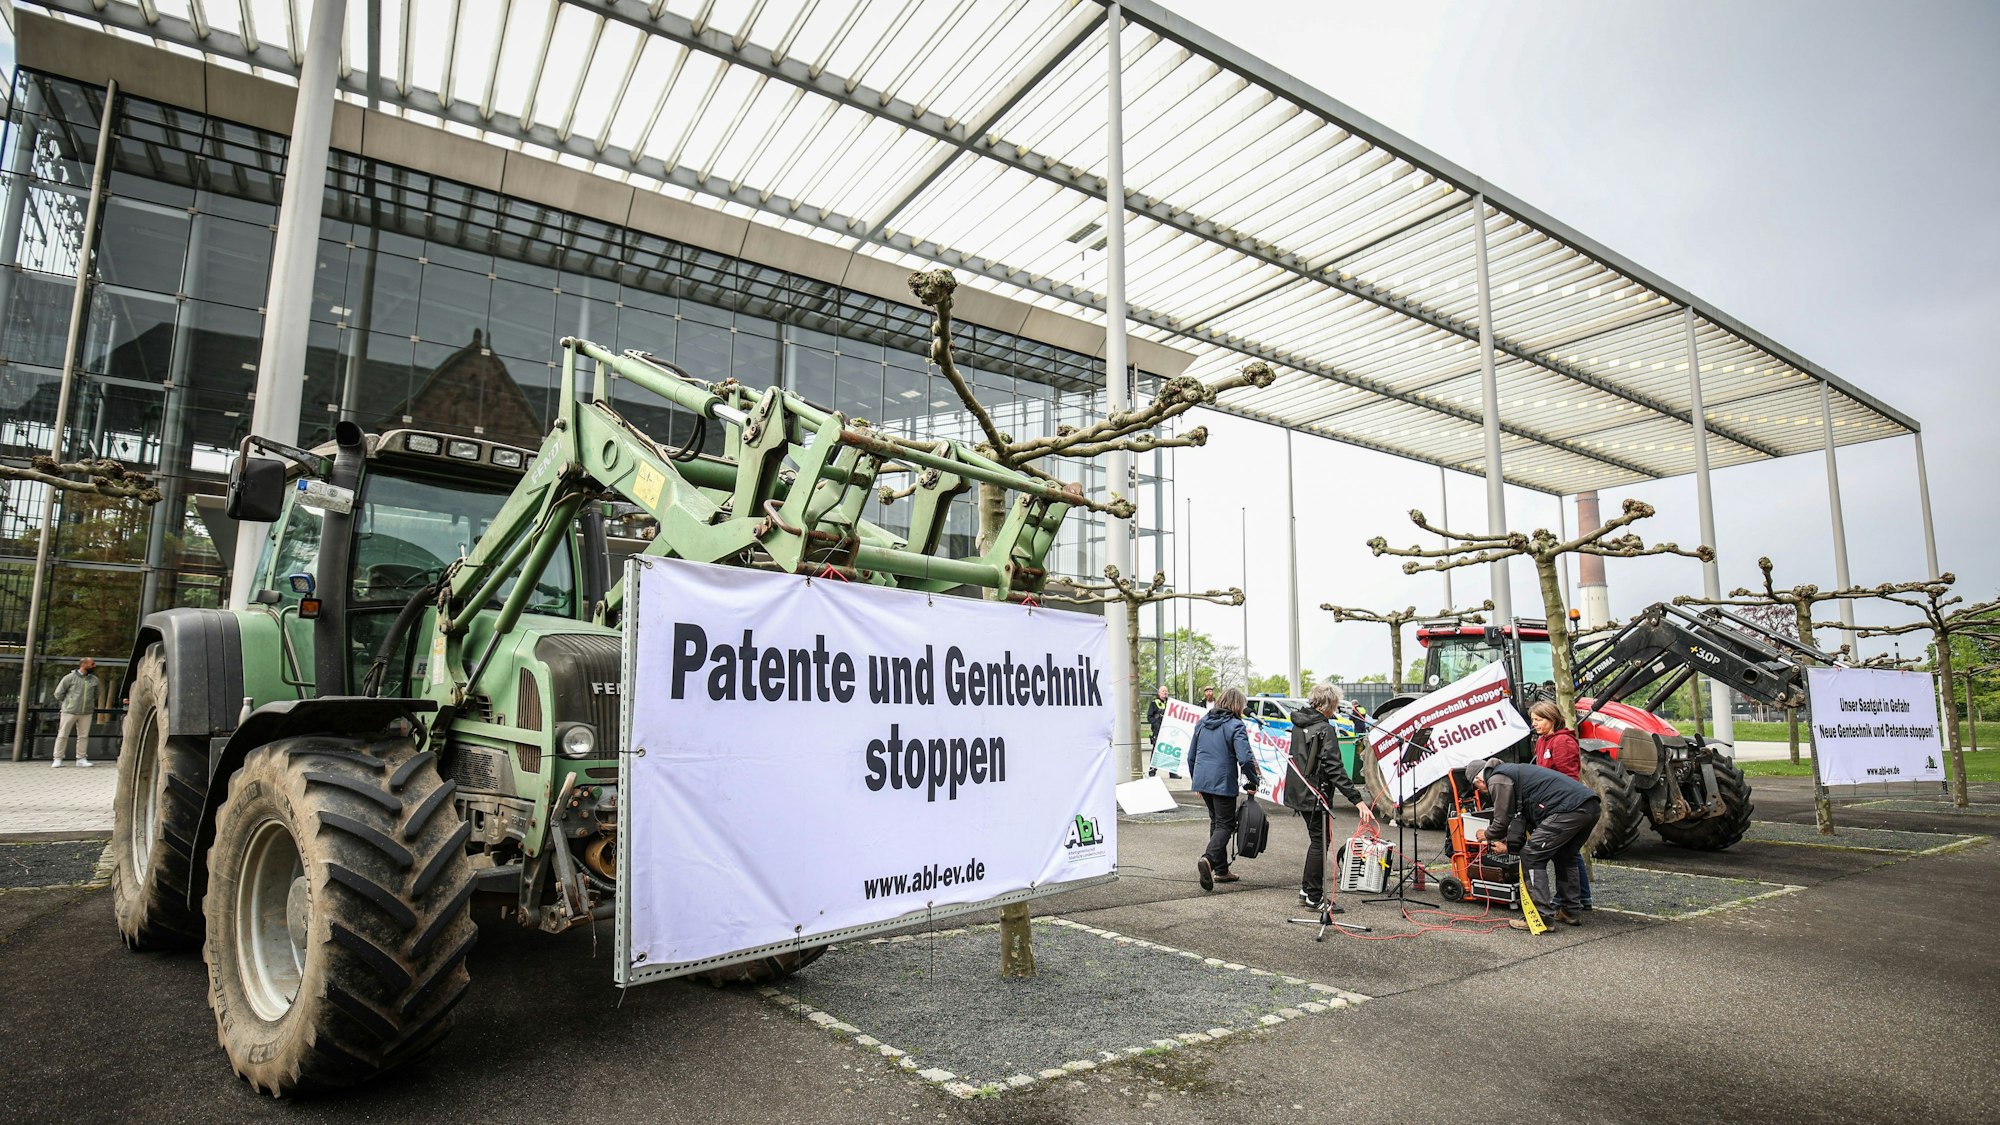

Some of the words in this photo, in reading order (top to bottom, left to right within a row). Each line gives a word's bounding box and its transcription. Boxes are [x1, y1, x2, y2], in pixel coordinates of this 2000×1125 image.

[671, 623, 855, 703] Patente
[869, 645, 934, 705] und
[945, 646, 1103, 706] Gentechnik
[1592, 656, 1615, 674] TRIMA
[1378, 723, 1415, 753] Höfestrben
[1420, 698, 1469, 725] Gentechnik
[1839, 698, 1857, 712] Unser
[1858, 698, 1882, 715] Saatgut
[1883, 698, 1889, 712] in
[1890, 699, 1910, 713] Gefahr
[1438, 714, 1498, 749] sichern
[1496, 709, 1507, 727] !
[1819, 724, 1836, 738] Neue
[1837, 723, 1872, 738] Gentechnik
[1873, 724, 1885, 737] und
[1885, 724, 1909, 738] Patente
[1909, 724, 1935, 741] stoppen!
[865, 724, 1005, 802] stoppen
[1157, 742, 1181, 758] CBG
[864, 858, 986, 900] www.abl-ev.de
